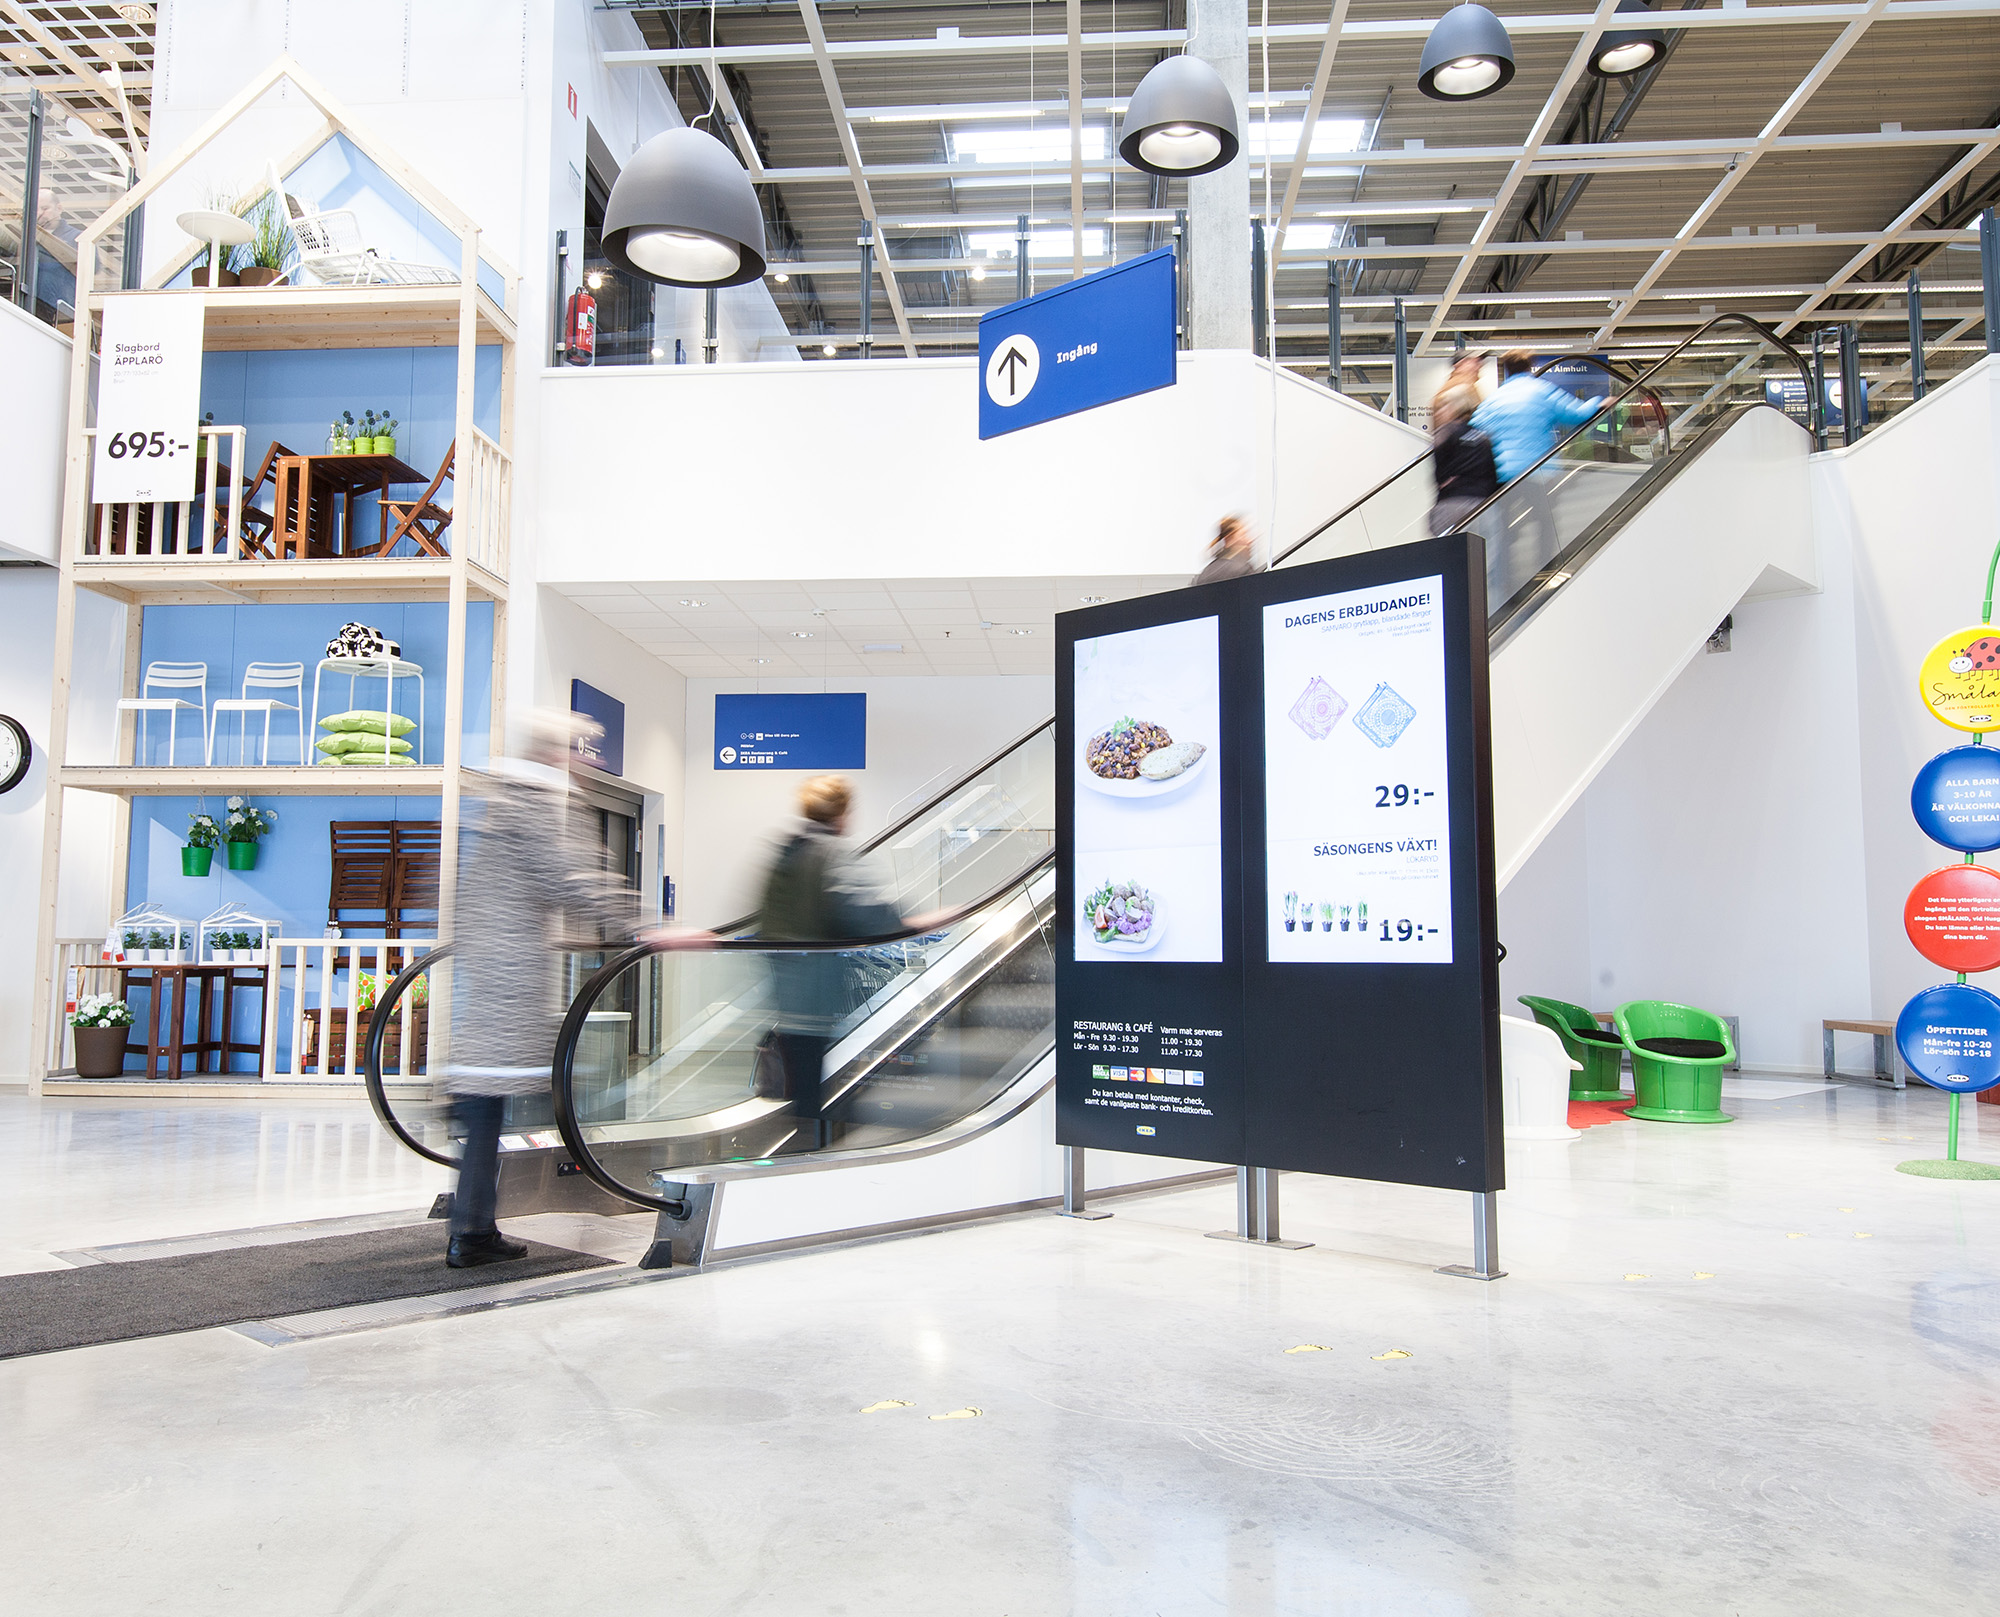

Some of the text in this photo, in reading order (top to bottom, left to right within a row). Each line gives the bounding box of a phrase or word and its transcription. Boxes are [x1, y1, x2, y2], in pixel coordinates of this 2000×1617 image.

[116, 343, 160, 354] Slagbord
[1057, 342, 1098, 364] Ingång
[114, 354, 163, 365] ÄPPLARÖ
[108, 431, 189, 459] 695:-
[1285, 593, 1430, 628] DAGENS ERBJUDANDE!
[1932, 683, 2000, 705] Småla
[4, 737, 9, 745] 2
[9, 748, 14, 757] 3
[1946, 778, 1999, 787] ALLA BARN
[1375, 784, 1434, 808] 29:-
[1953, 790, 1992, 799] 3-10 ÅR
[1932, 802, 2000, 811] ÄR VÄLKOMNA
[1313, 837, 1437, 856] SÄSONGENS VÄXT!
[1379, 919, 1438, 941] 19:-
[1074, 1021, 1153, 1033] RESTAURANG & CAFÉ
[1160, 1026, 1177, 1034] Varm
[1194, 1029, 1223, 1037] serveras
[1926, 1025, 1988, 1036] ÖPPETTIDER
[1074, 1031, 1085, 1040] Mån
[1091, 1033, 1100, 1041] Fre
[1103, 1034, 1116, 1042] 9.30
[1122, 1035, 1139, 1043] 19.30
[1161, 1037, 1178, 1045] 11.00
[1185, 1038, 1203, 1046] 19.30
[1088, 1043, 1099, 1051] Sön
[1103, 1044, 1116, 1052] 9.30
[1122, 1045, 1139, 1054] 17.30
[1924, 1038, 1992, 1049] Mån-fre 10-20
[1161, 1048, 1178, 1056] 11.00
[1185, 1049, 1203, 1057] 17.30
[1924, 1047, 1991, 1058] Lör-sön 10-18
[1092, 1088, 1101, 1096] Du
[1115, 1090, 1134, 1099] betala
[1135, 1093, 1149, 1101] med
[1150, 1093, 1182, 1105] kontanter,
[1183, 1096, 1205, 1107] check,
[1100, 1098, 1108, 1106] de
[1109, 1100, 1140, 1109] vanligaste
[1141, 1102, 1158, 1110] bank-
[1159, 1104, 1171, 1112] och
[1172, 1105, 1213, 1115] kreditkorten.
